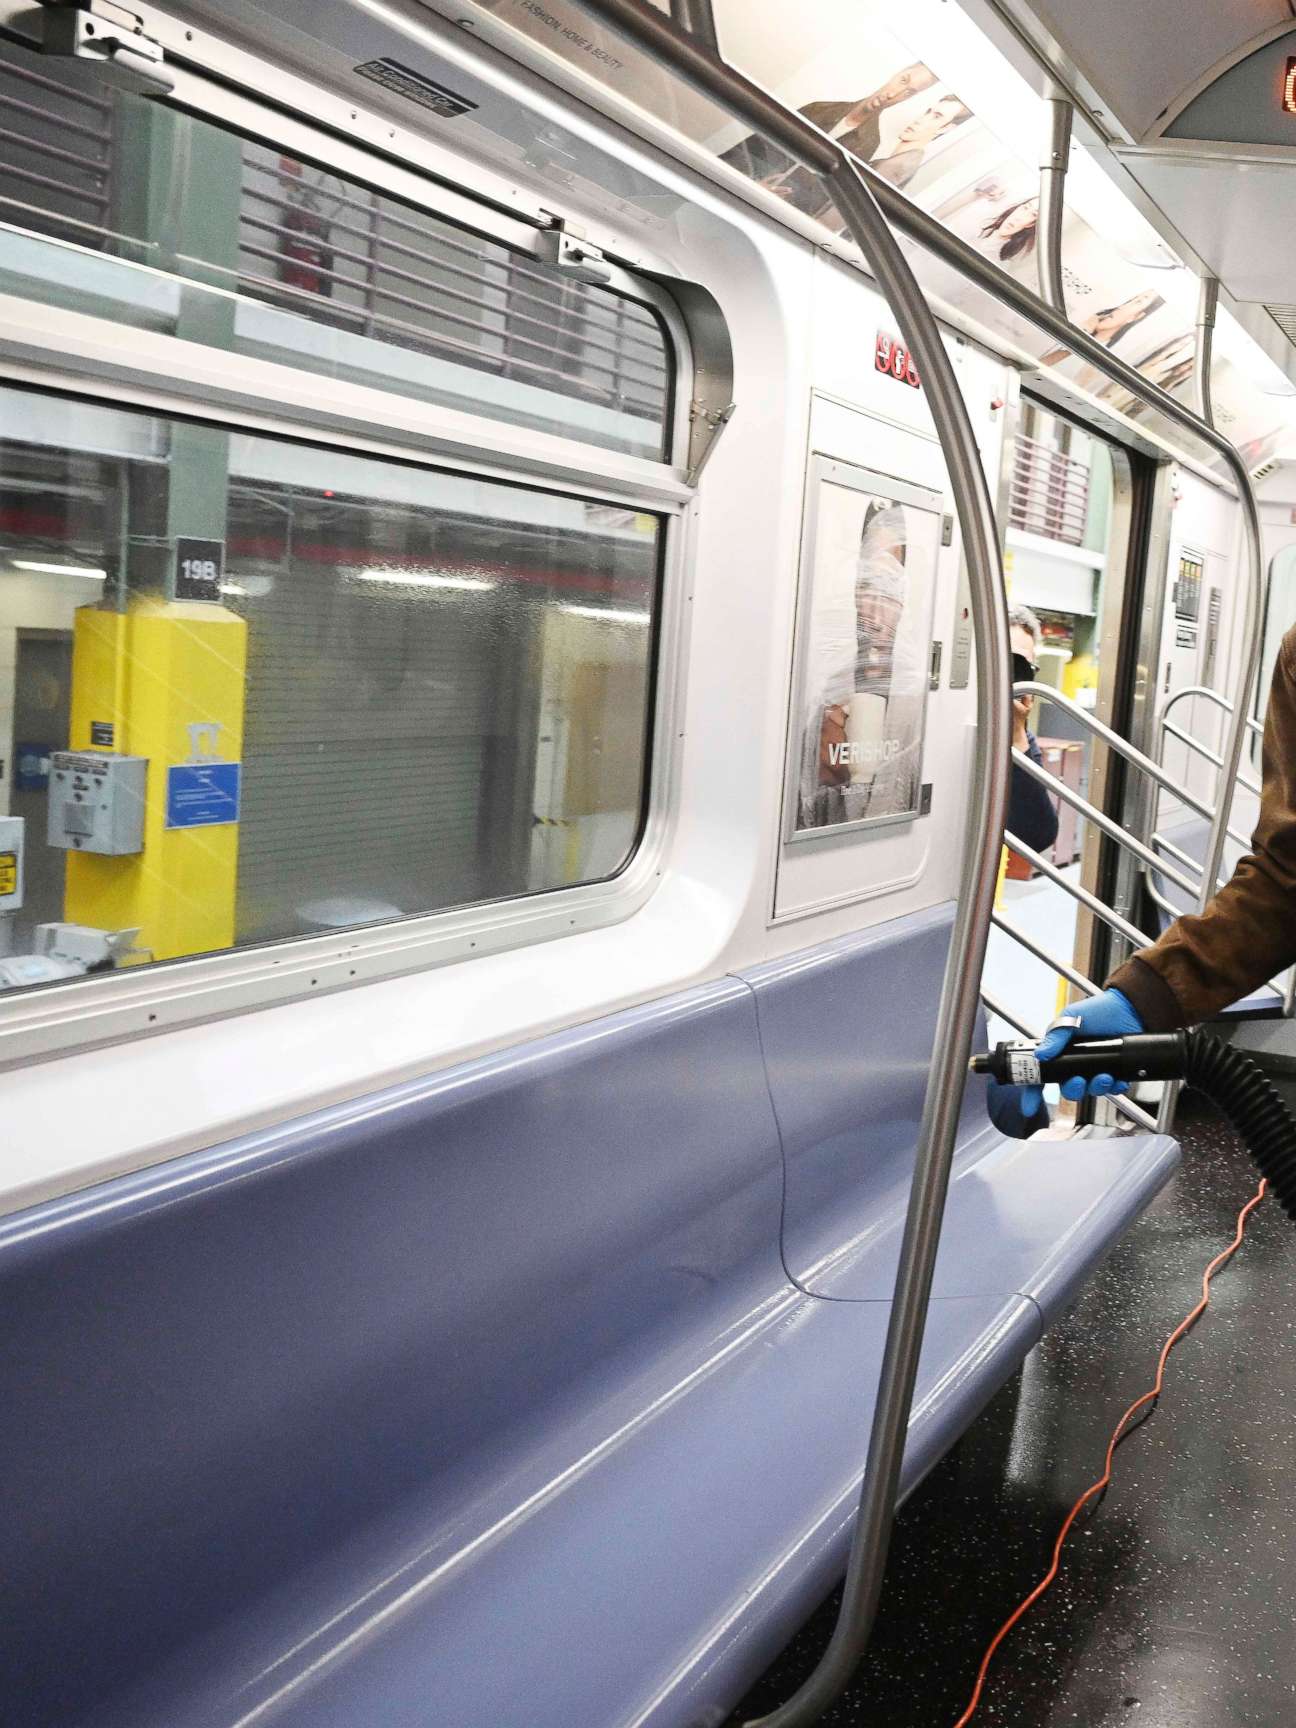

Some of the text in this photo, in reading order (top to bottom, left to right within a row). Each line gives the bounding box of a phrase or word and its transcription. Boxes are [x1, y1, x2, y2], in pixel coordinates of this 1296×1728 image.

[561, 27, 588, 48] HOME
[591, 48, 625, 69] BEAUTY
[181, 559, 217, 581] 19B
[828, 739, 900, 767] VERISHOP
